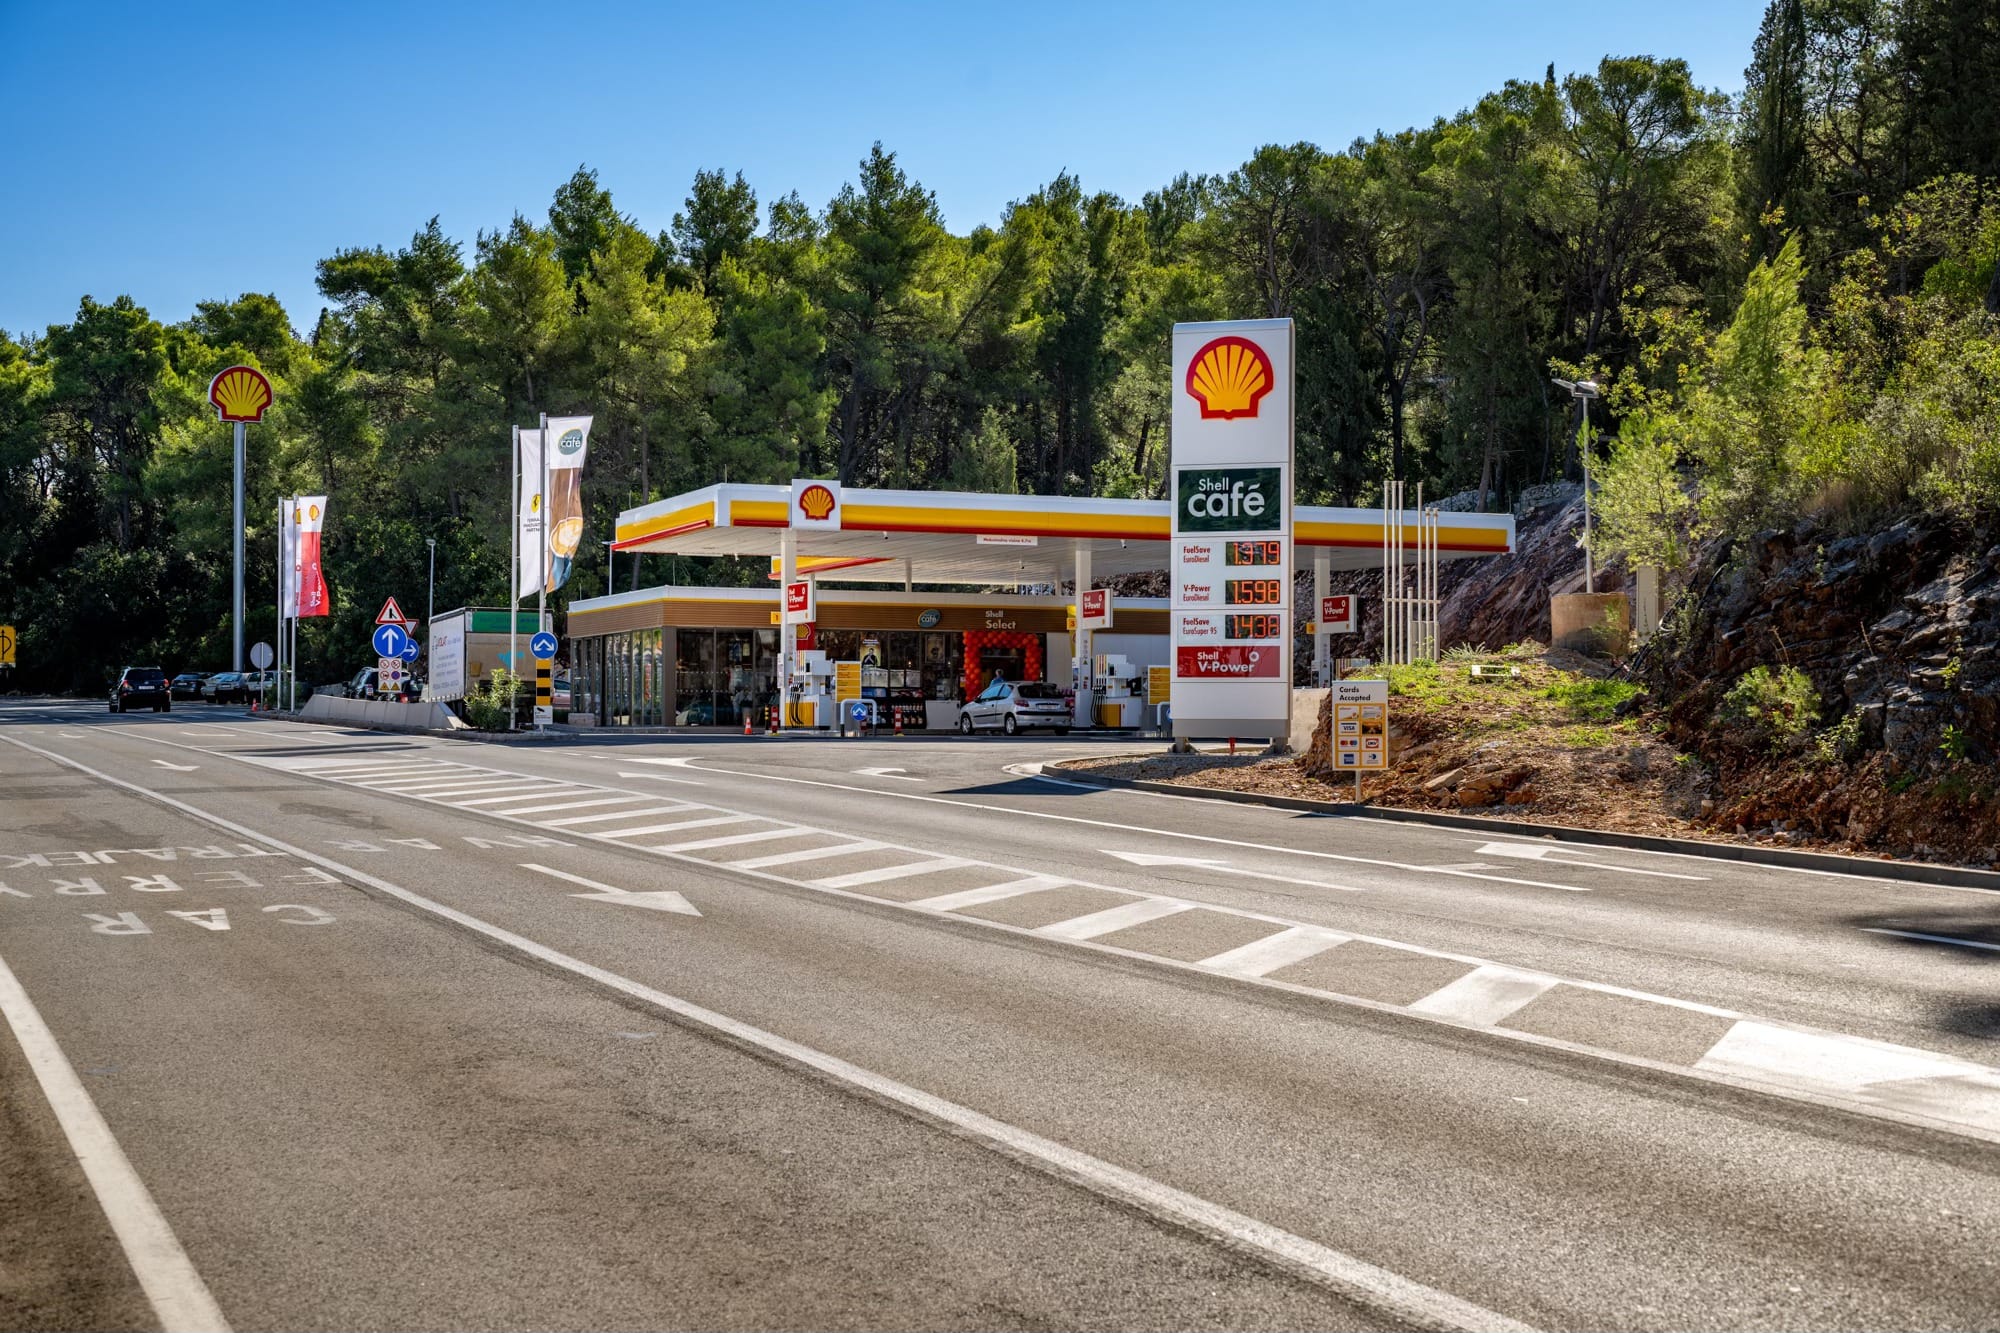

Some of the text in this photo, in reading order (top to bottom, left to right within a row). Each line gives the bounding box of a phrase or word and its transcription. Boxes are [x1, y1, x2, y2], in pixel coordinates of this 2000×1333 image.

[1198, 477, 1230, 492] Shell
[1187, 481, 1266, 518] café
[1183, 545, 1211, 554] FuelSave
[1183, 555, 1210, 563] EuroDiesel
[1183, 584, 1211, 592] V-Power
[1232, 581, 1280, 604] 1.598
[1183, 594, 1210, 602] EuroDiesel
[985, 610, 1004, 618] Shell
[985, 619, 1017, 630] Select
[1183, 617, 1210, 626] FuelSave
[1232, 615, 1280, 638] 1.438
[1183, 627, 1218, 636] EuroSuper 95
[1197, 651, 1219, 660] Shell
[1197, 661, 1255, 672] V-Power
[1339, 694, 1371, 702] Accepted
[82, 904, 337, 935] CAR
